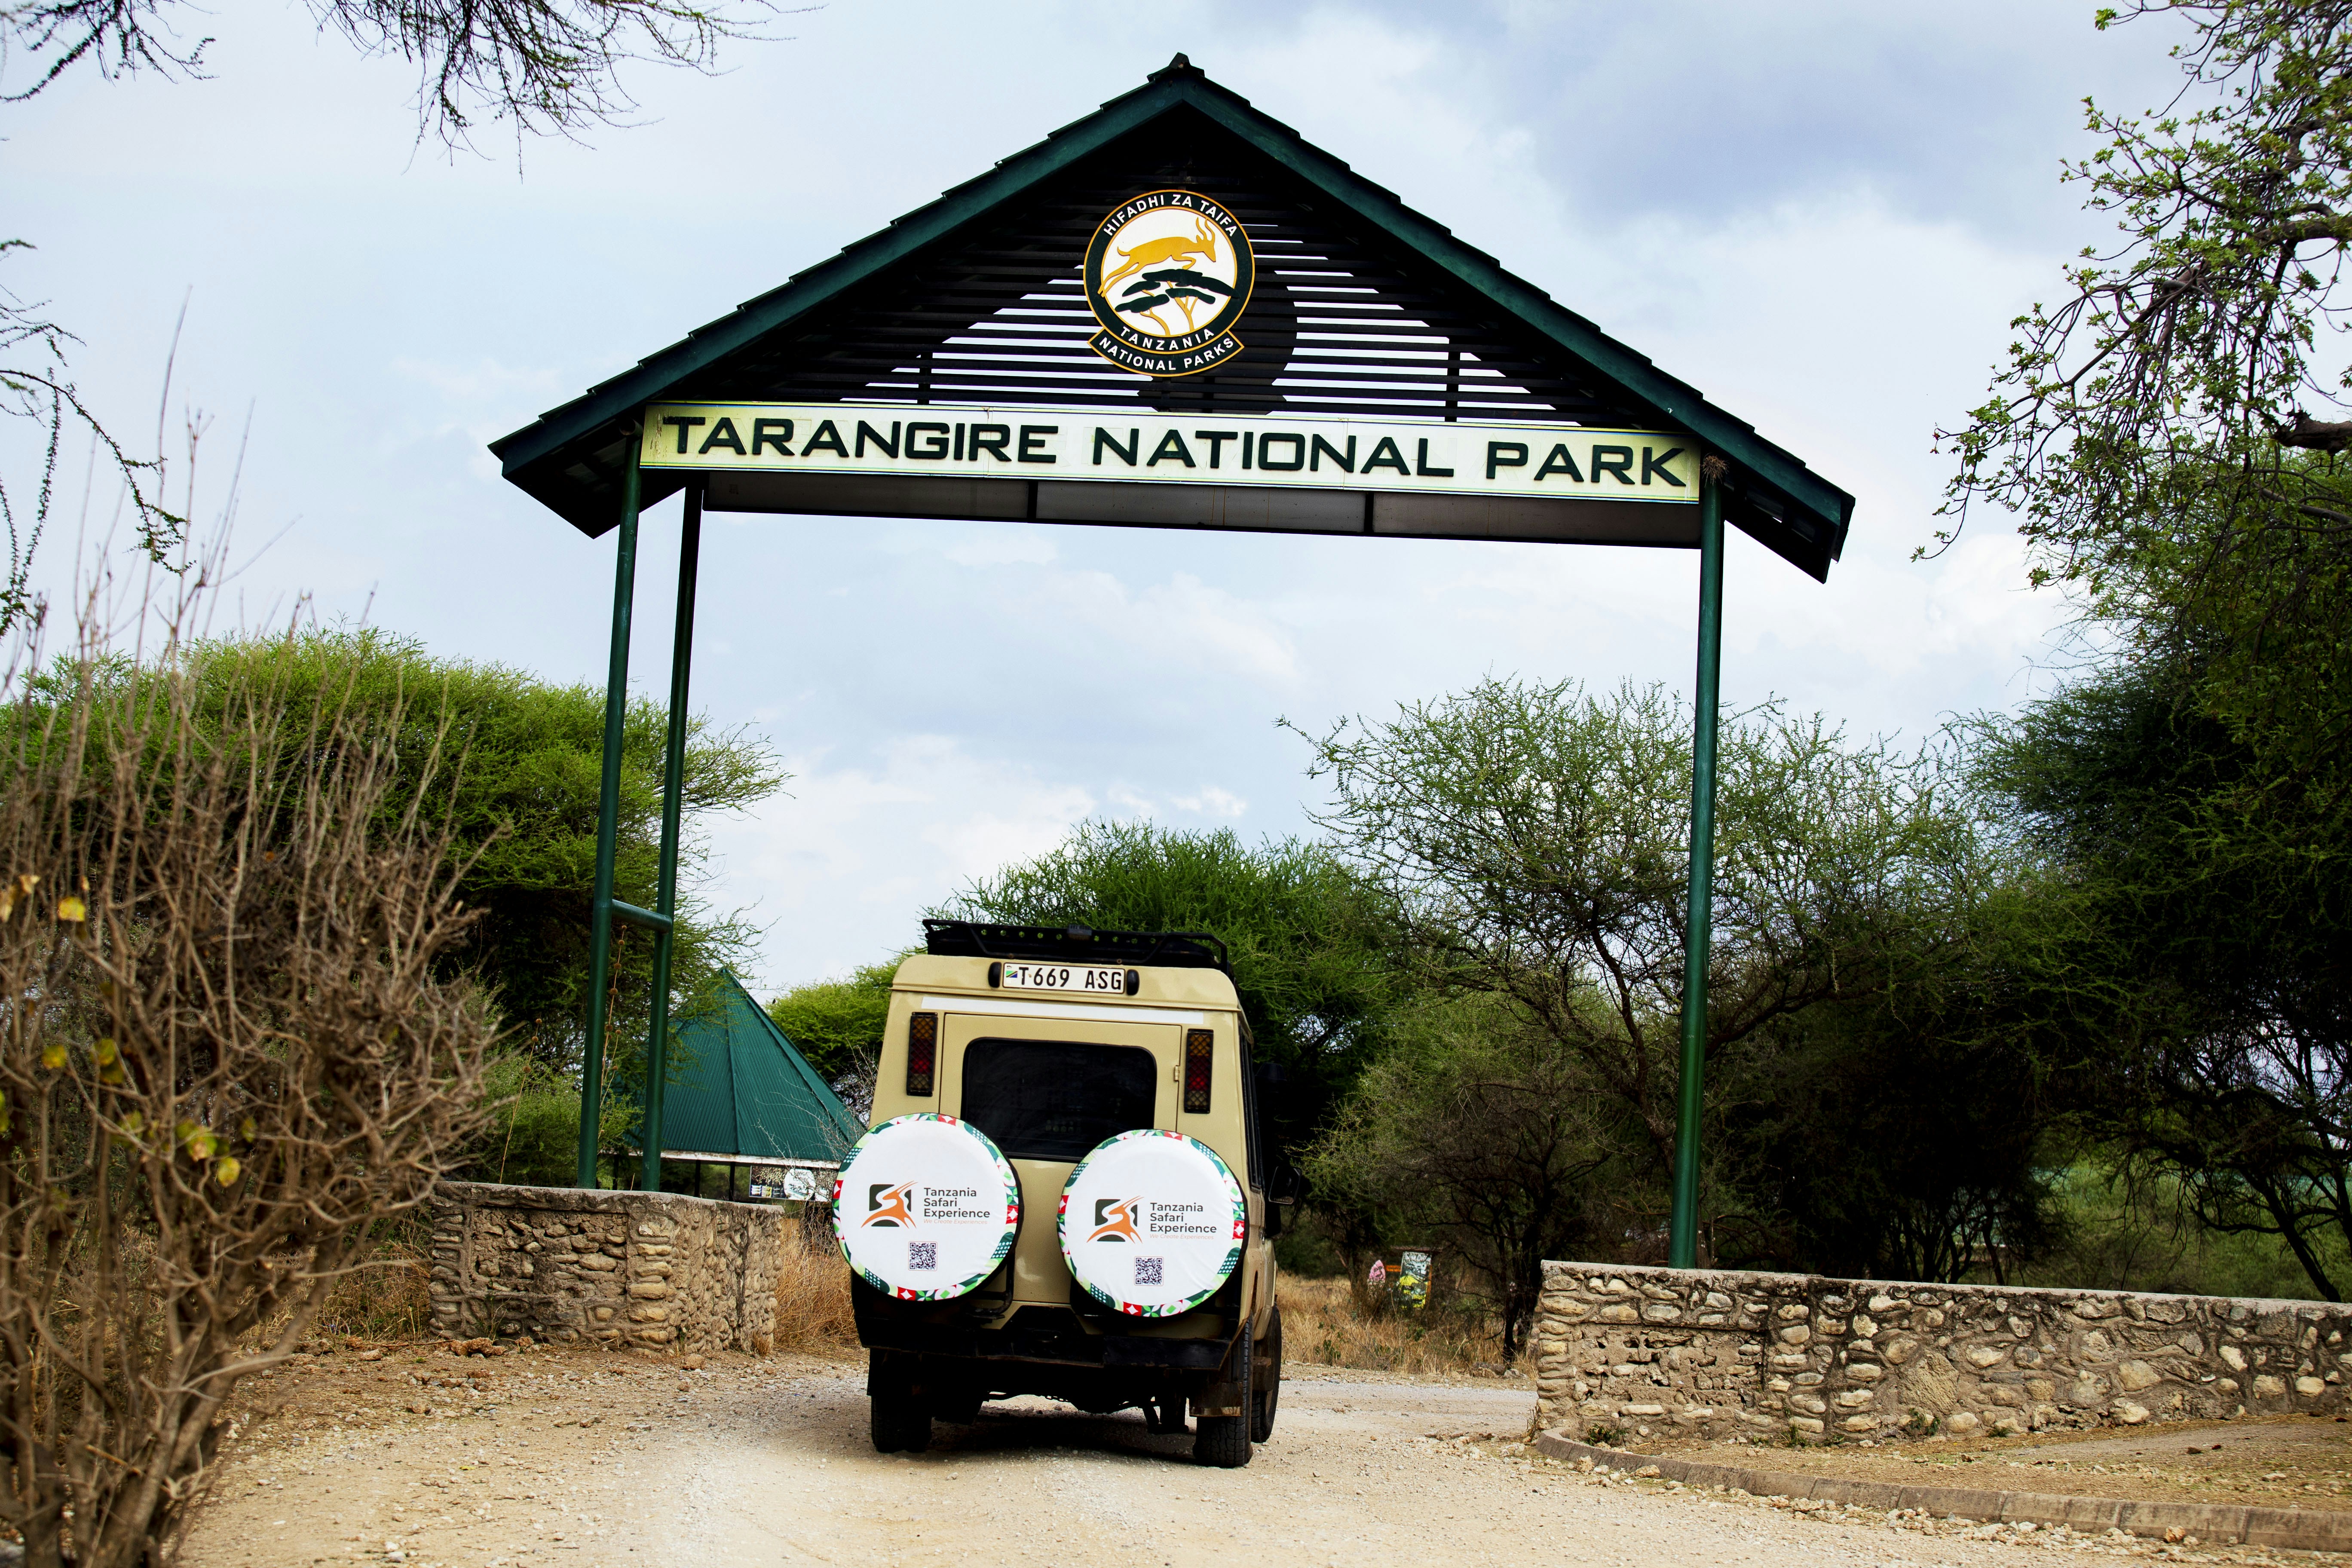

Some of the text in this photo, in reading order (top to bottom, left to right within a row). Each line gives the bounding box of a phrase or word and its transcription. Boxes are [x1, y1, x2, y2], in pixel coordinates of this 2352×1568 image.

[1103, 194, 1237, 237] HIFADHI ZA TAIFA
[1120, 326, 1215, 351] TANZANIA
[1099, 337, 1234, 371] NATIONAL PARKS
[663, 416, 1686, 487] TARANGIRE NATIONAL PARK
[1084, 970, 1122, 990] ASG
[924, 1187, 977, 1197] Tanzania
[924, 1197, 957, 1207] Safari
[1150, 1202, 1203, 1212] Tanzania
[924, 1208, 990, 1219] Experience
[1150, 1213, 1183, 1222] Safari
[1150, 1223, 1217, 1234] Experience
